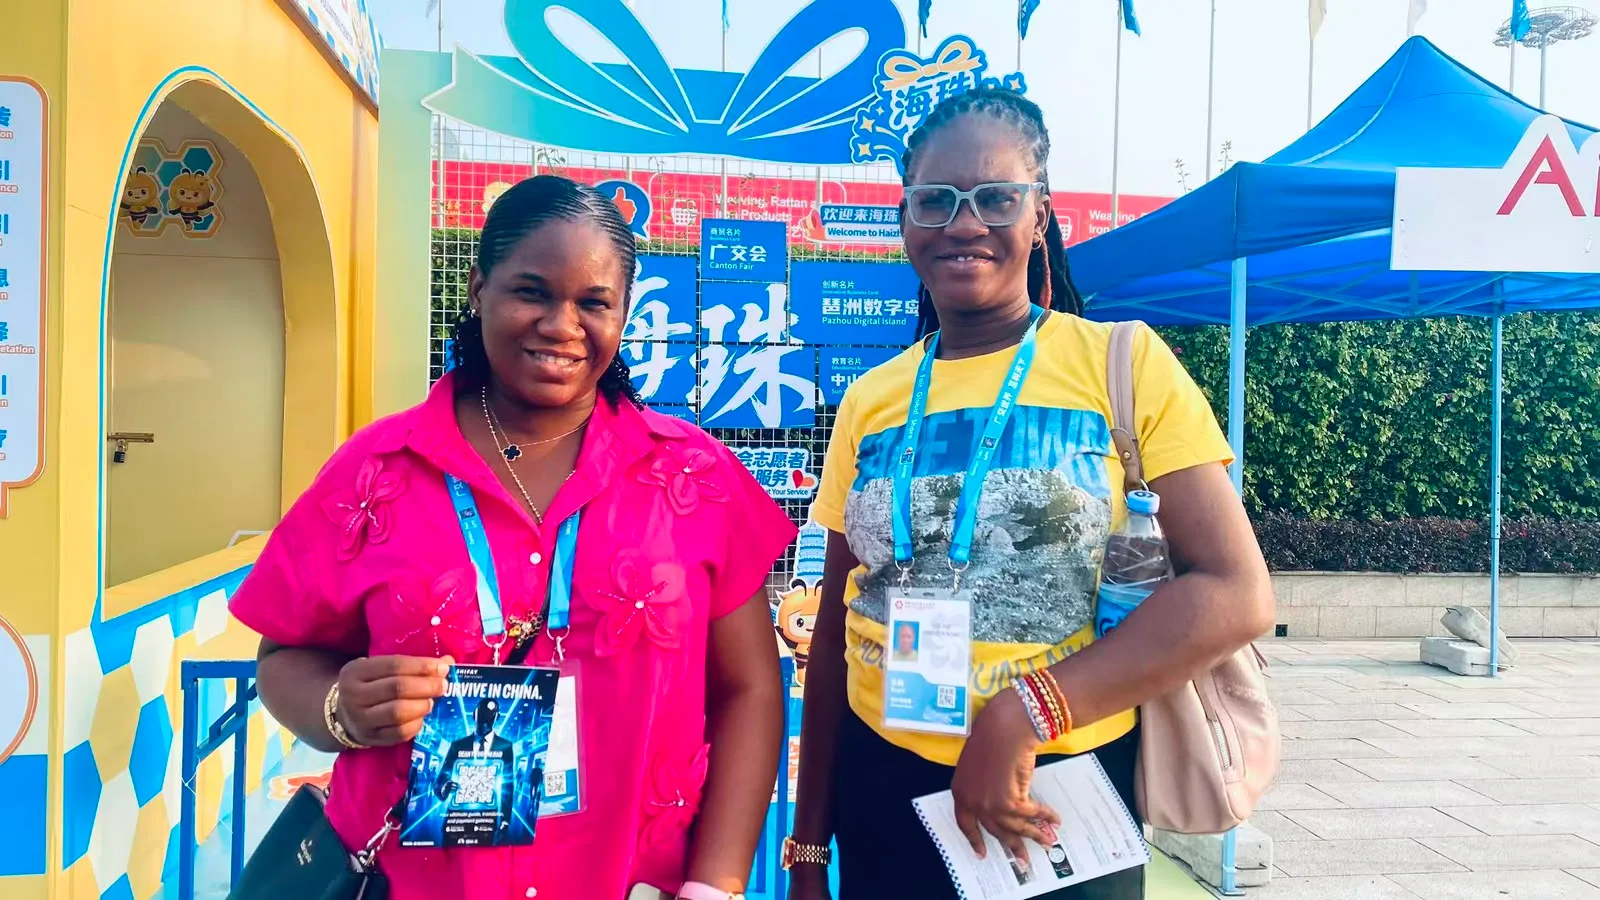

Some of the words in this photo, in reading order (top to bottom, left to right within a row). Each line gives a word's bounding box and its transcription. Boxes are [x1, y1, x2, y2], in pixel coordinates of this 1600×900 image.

[770, 195, 808, 208] Rattan
[741, 209, 793, 221] Products
[822, 207, 899, 223] 欢迎来海珠
[710, 227, 741, 236] 商贸名片
[827, 227, 867, 237] Welcome
[868, 229, 878, 237] to
[710, 244, 767, 262] 广交会
[709, 261, 738, 270] Canton
[740, 262, 754, 271] Fair
[822, 280, 855, 290] 创新名片
[822, 297, 919, 317] 琶洲数字岛
[822, 316, 852, 325] Pazhou
[854, 317, 880, 327] Digital
[882, 317, 907, 326] Island
[831, 357, 861, 365] 教育名片
[737, 451, 805, 469] 会志愿者
[772, 488, 786, 496] Your
[788, 488, 809, 496] Service
[443, 682, 487, 698] URVIVE
[488, 682, 502, 698] IN
[503, 683, 543, 700] CHINA.
